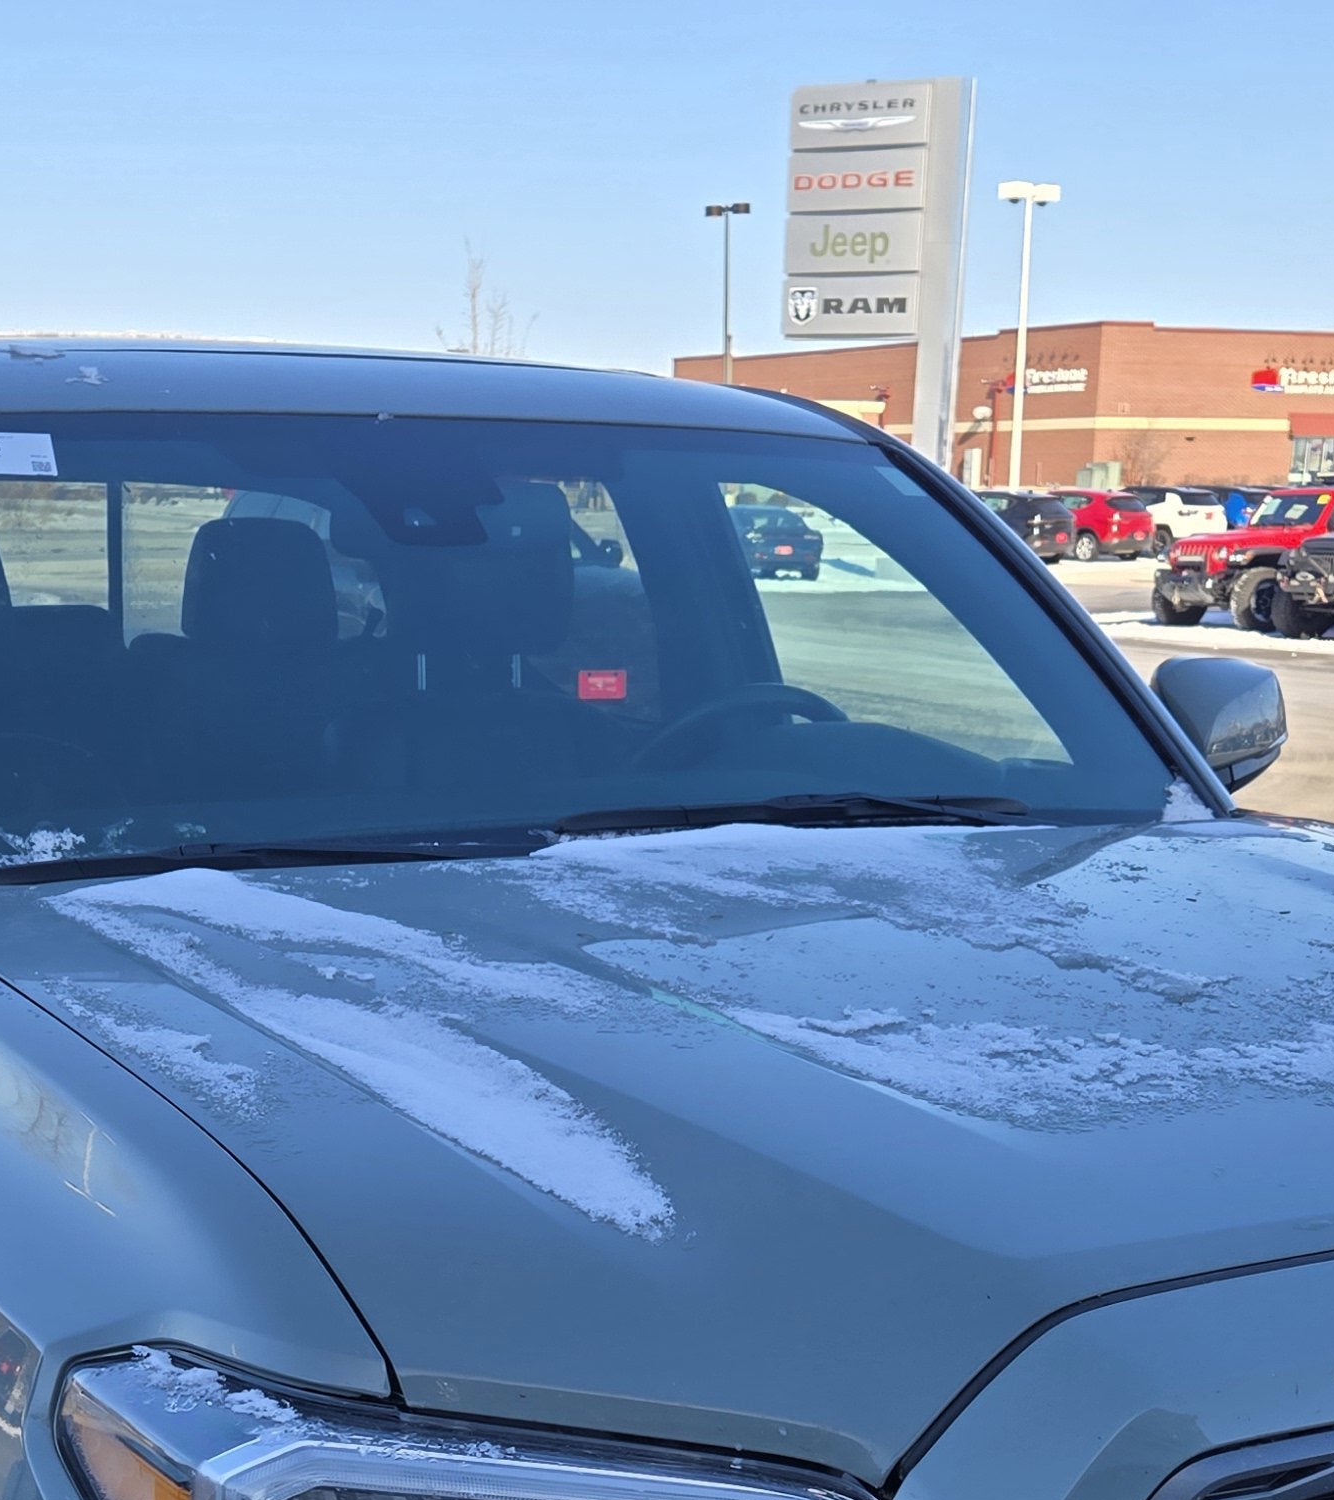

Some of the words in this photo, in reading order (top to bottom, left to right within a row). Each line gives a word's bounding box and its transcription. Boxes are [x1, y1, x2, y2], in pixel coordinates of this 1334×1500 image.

[799, 98, 916, 114] CHRYSLER
[793, 170, 915, 191] DODGE
[810, 224, 890, 263] Jeep
[822, 297, 907, 314] RAM
